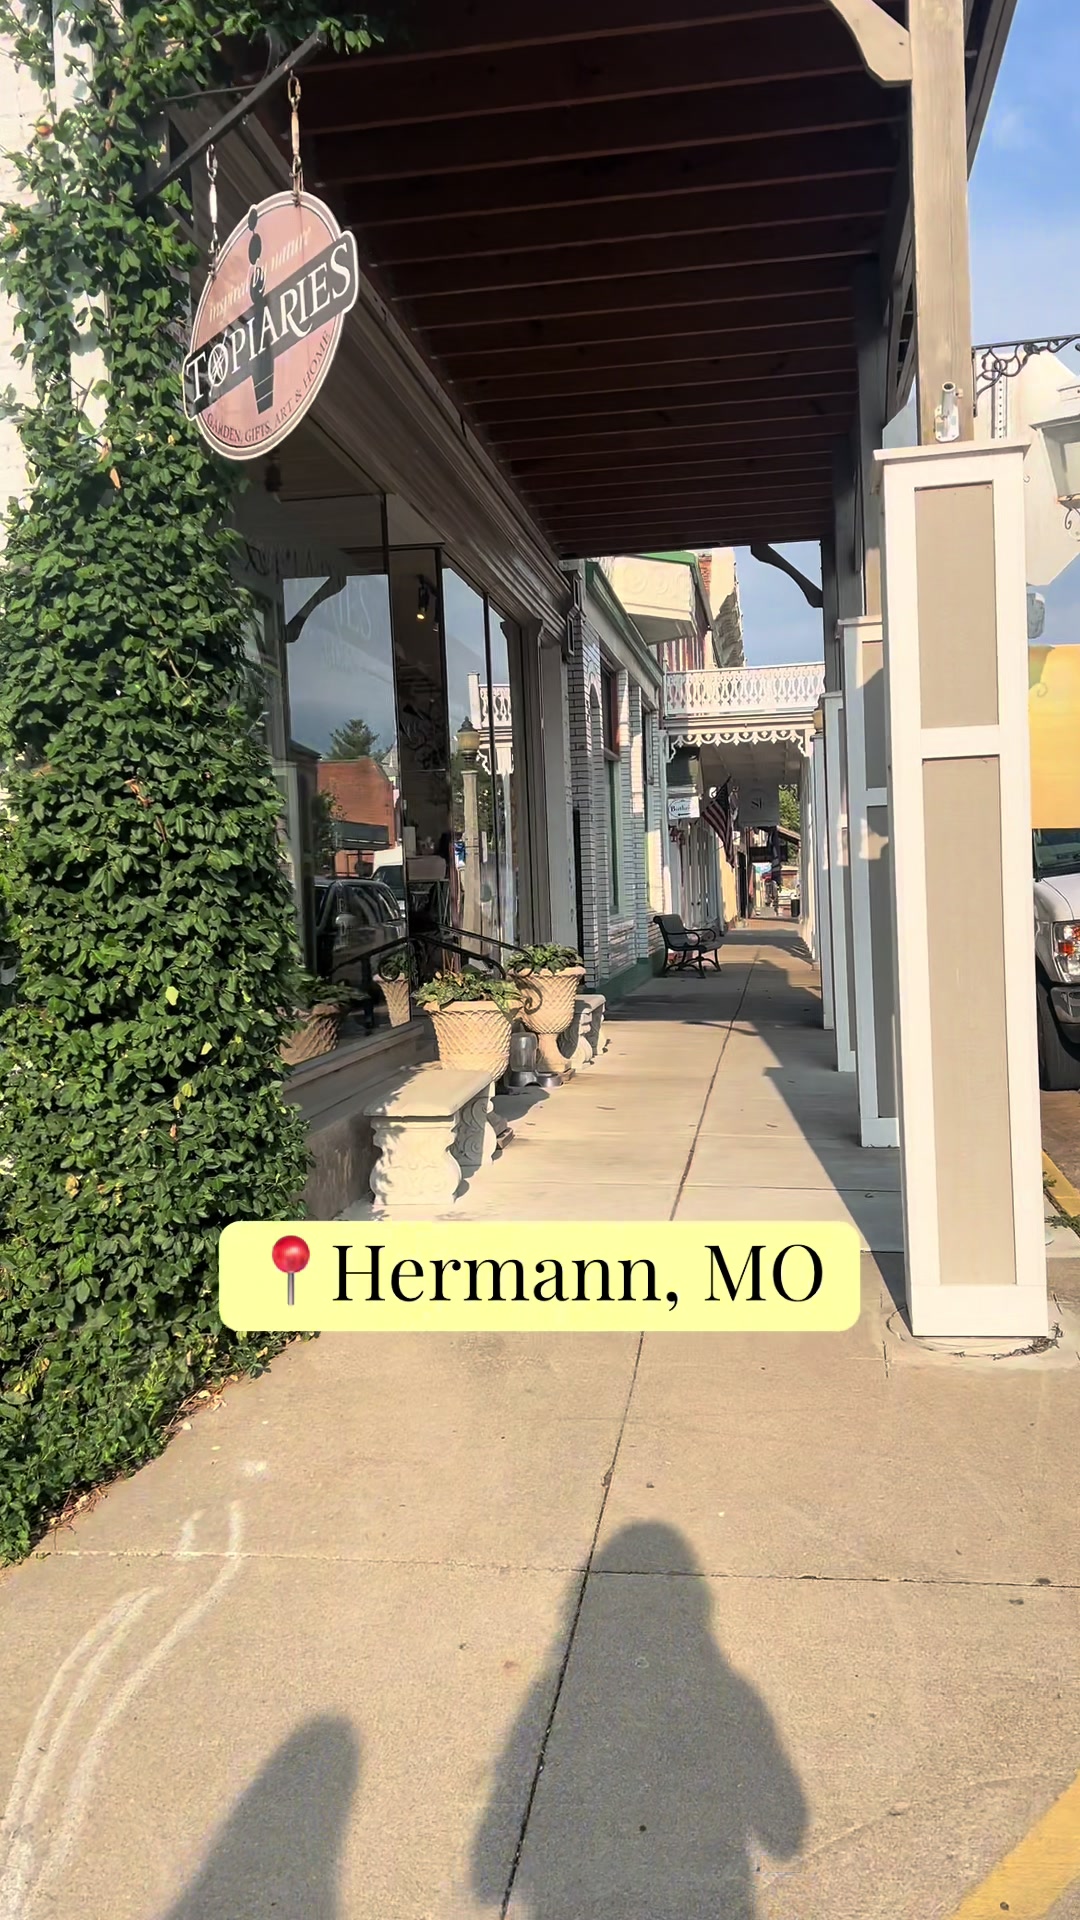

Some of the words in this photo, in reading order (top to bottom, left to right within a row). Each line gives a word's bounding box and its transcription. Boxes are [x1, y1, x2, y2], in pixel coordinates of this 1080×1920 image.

[186, 242, 351, 402] TOPIARIES
[274, 398, 293, 428] ART
[302, 330, 331, 389] HOME
